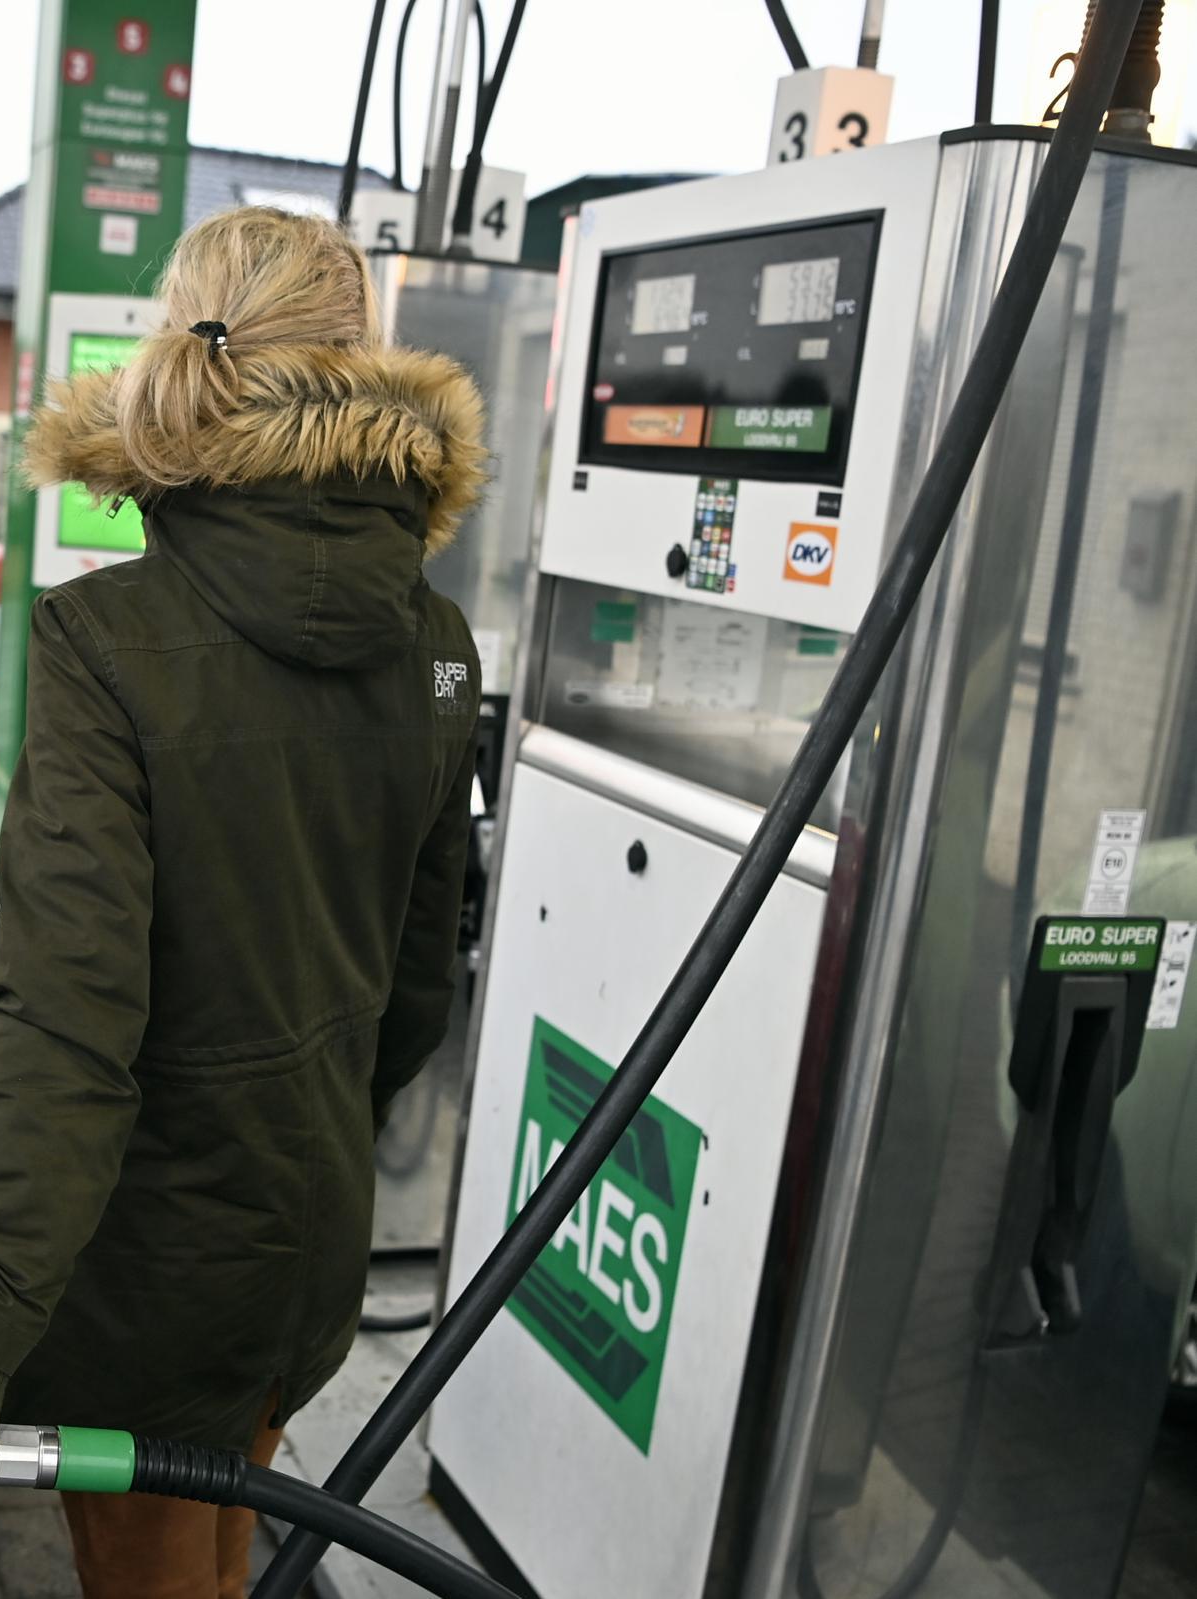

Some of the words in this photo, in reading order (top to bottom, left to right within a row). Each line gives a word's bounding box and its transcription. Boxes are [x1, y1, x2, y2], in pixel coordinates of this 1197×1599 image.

[779, 111, 808, 163] 3
[482, 199, 507, 240] 4
[376, 219, 401, 251] 5
[735, 408, 769, 427] EURO
[771, 408, 813, 428] SUPER
[792, 544, 830, 563] DKV
[433, 660, 467, 681] SUPER
[435, 680, 456, 698] DRY
[1105, 857, 1123, 869] E10
[1045, 926, 1096, 945] EURO
[1100, 926, 1159, 945] SUPER
[1059, 951, 1118, 966] LOODVRIJ
